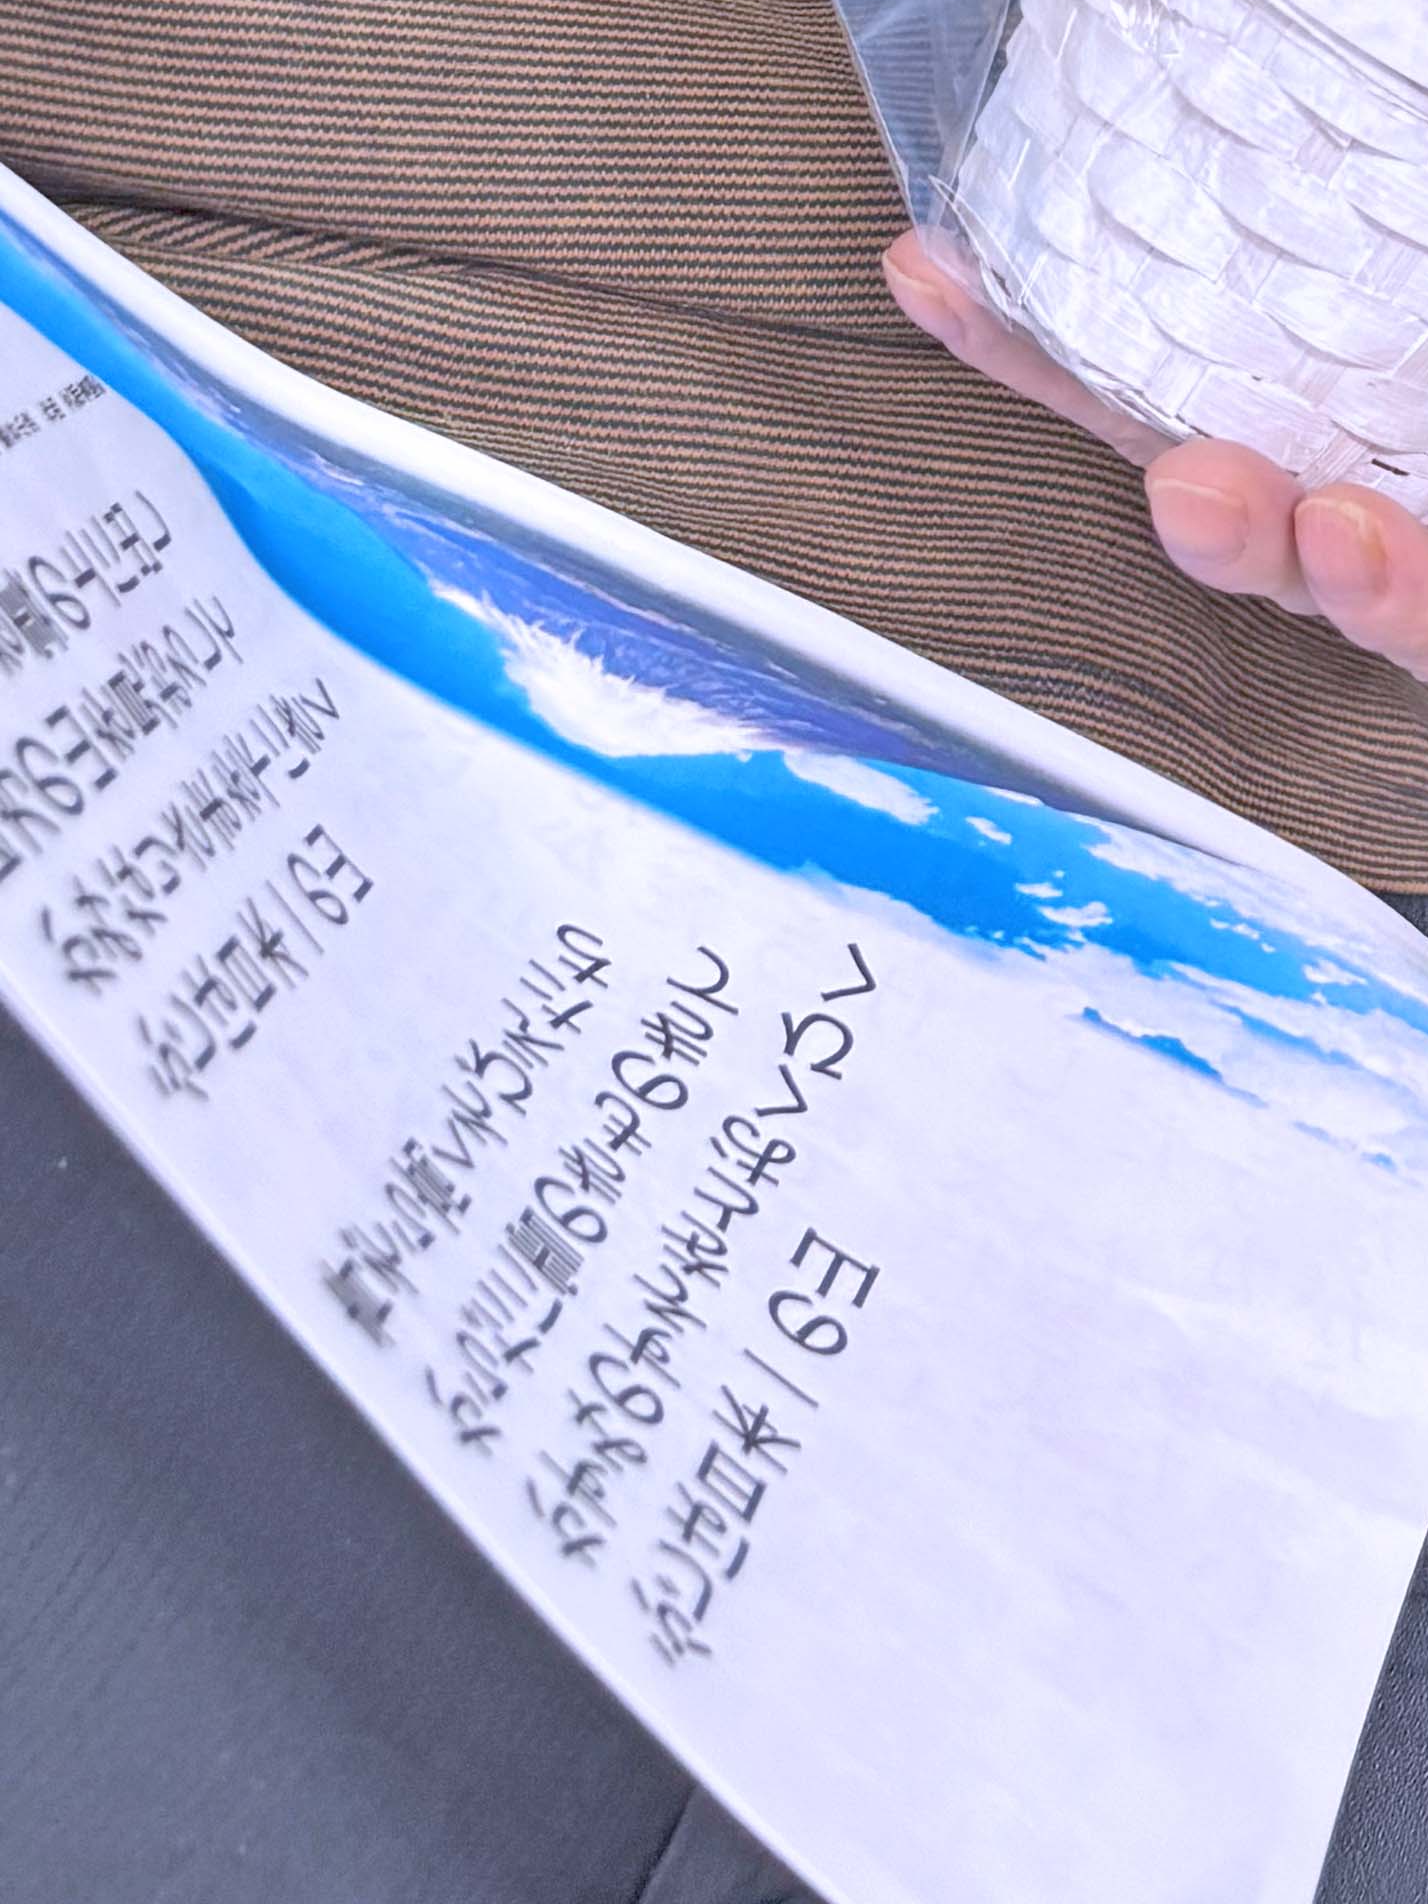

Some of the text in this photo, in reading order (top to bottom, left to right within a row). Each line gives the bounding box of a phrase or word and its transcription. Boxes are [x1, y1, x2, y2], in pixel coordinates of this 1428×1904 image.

[0, 595, 244, 883] 方の山を見おろして
[136, 823, 375, 1103] ふじは日本一の山
[424, 945, 739, 1456] からだに雪のきものきて
[526, 942, 878, 1566] かすみのすそをとおくひく
[631, 1227, 880, 1667] ふじは日本一の山
